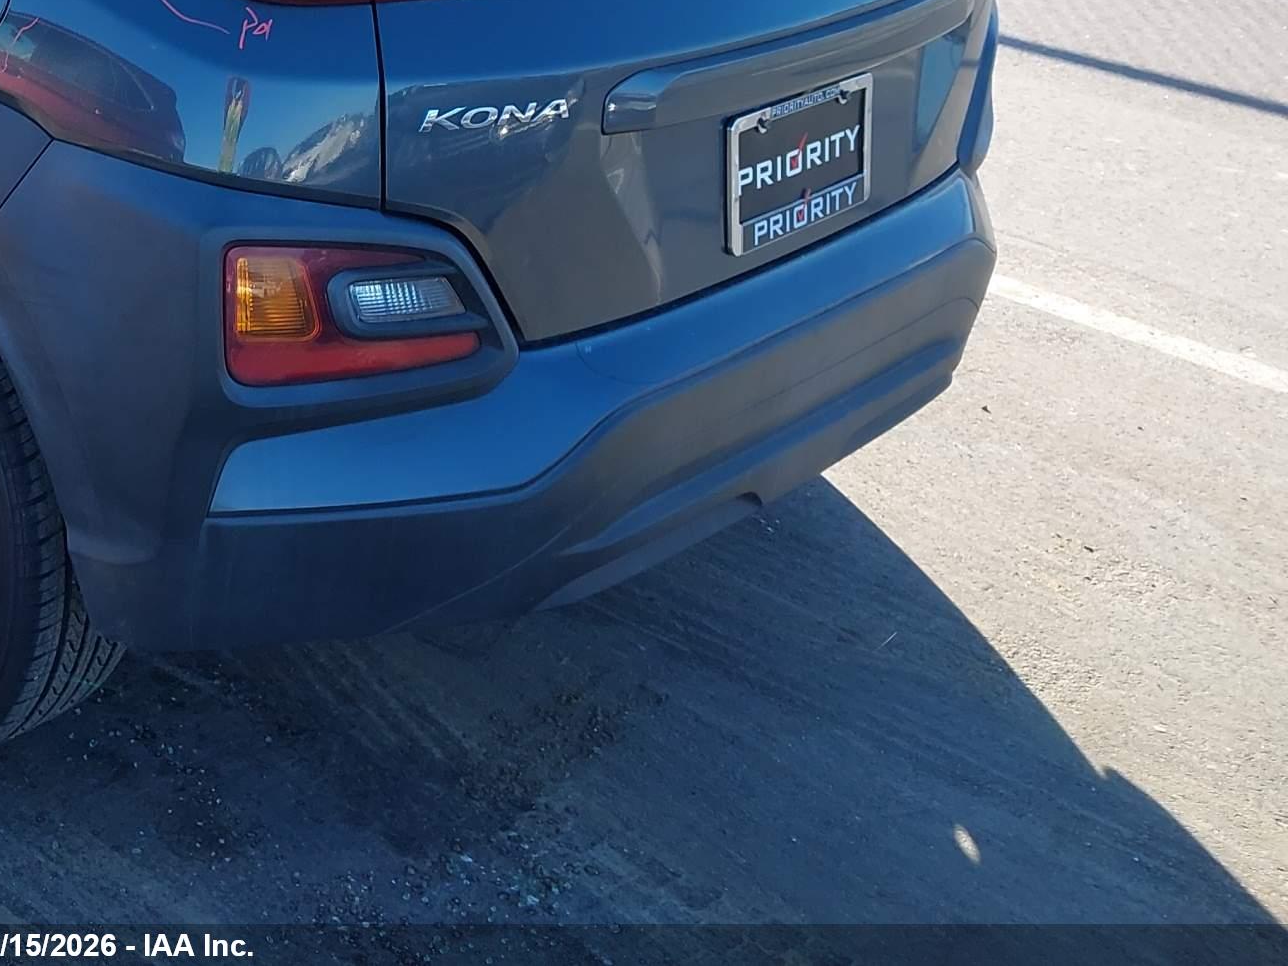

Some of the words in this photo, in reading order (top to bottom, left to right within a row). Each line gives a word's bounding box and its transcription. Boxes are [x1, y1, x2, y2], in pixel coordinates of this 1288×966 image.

[418, 98, 570, 133] KONA
[738, 123, 860, 196] PRIORITY
[754, 181, 857, 246] PRIORITY
